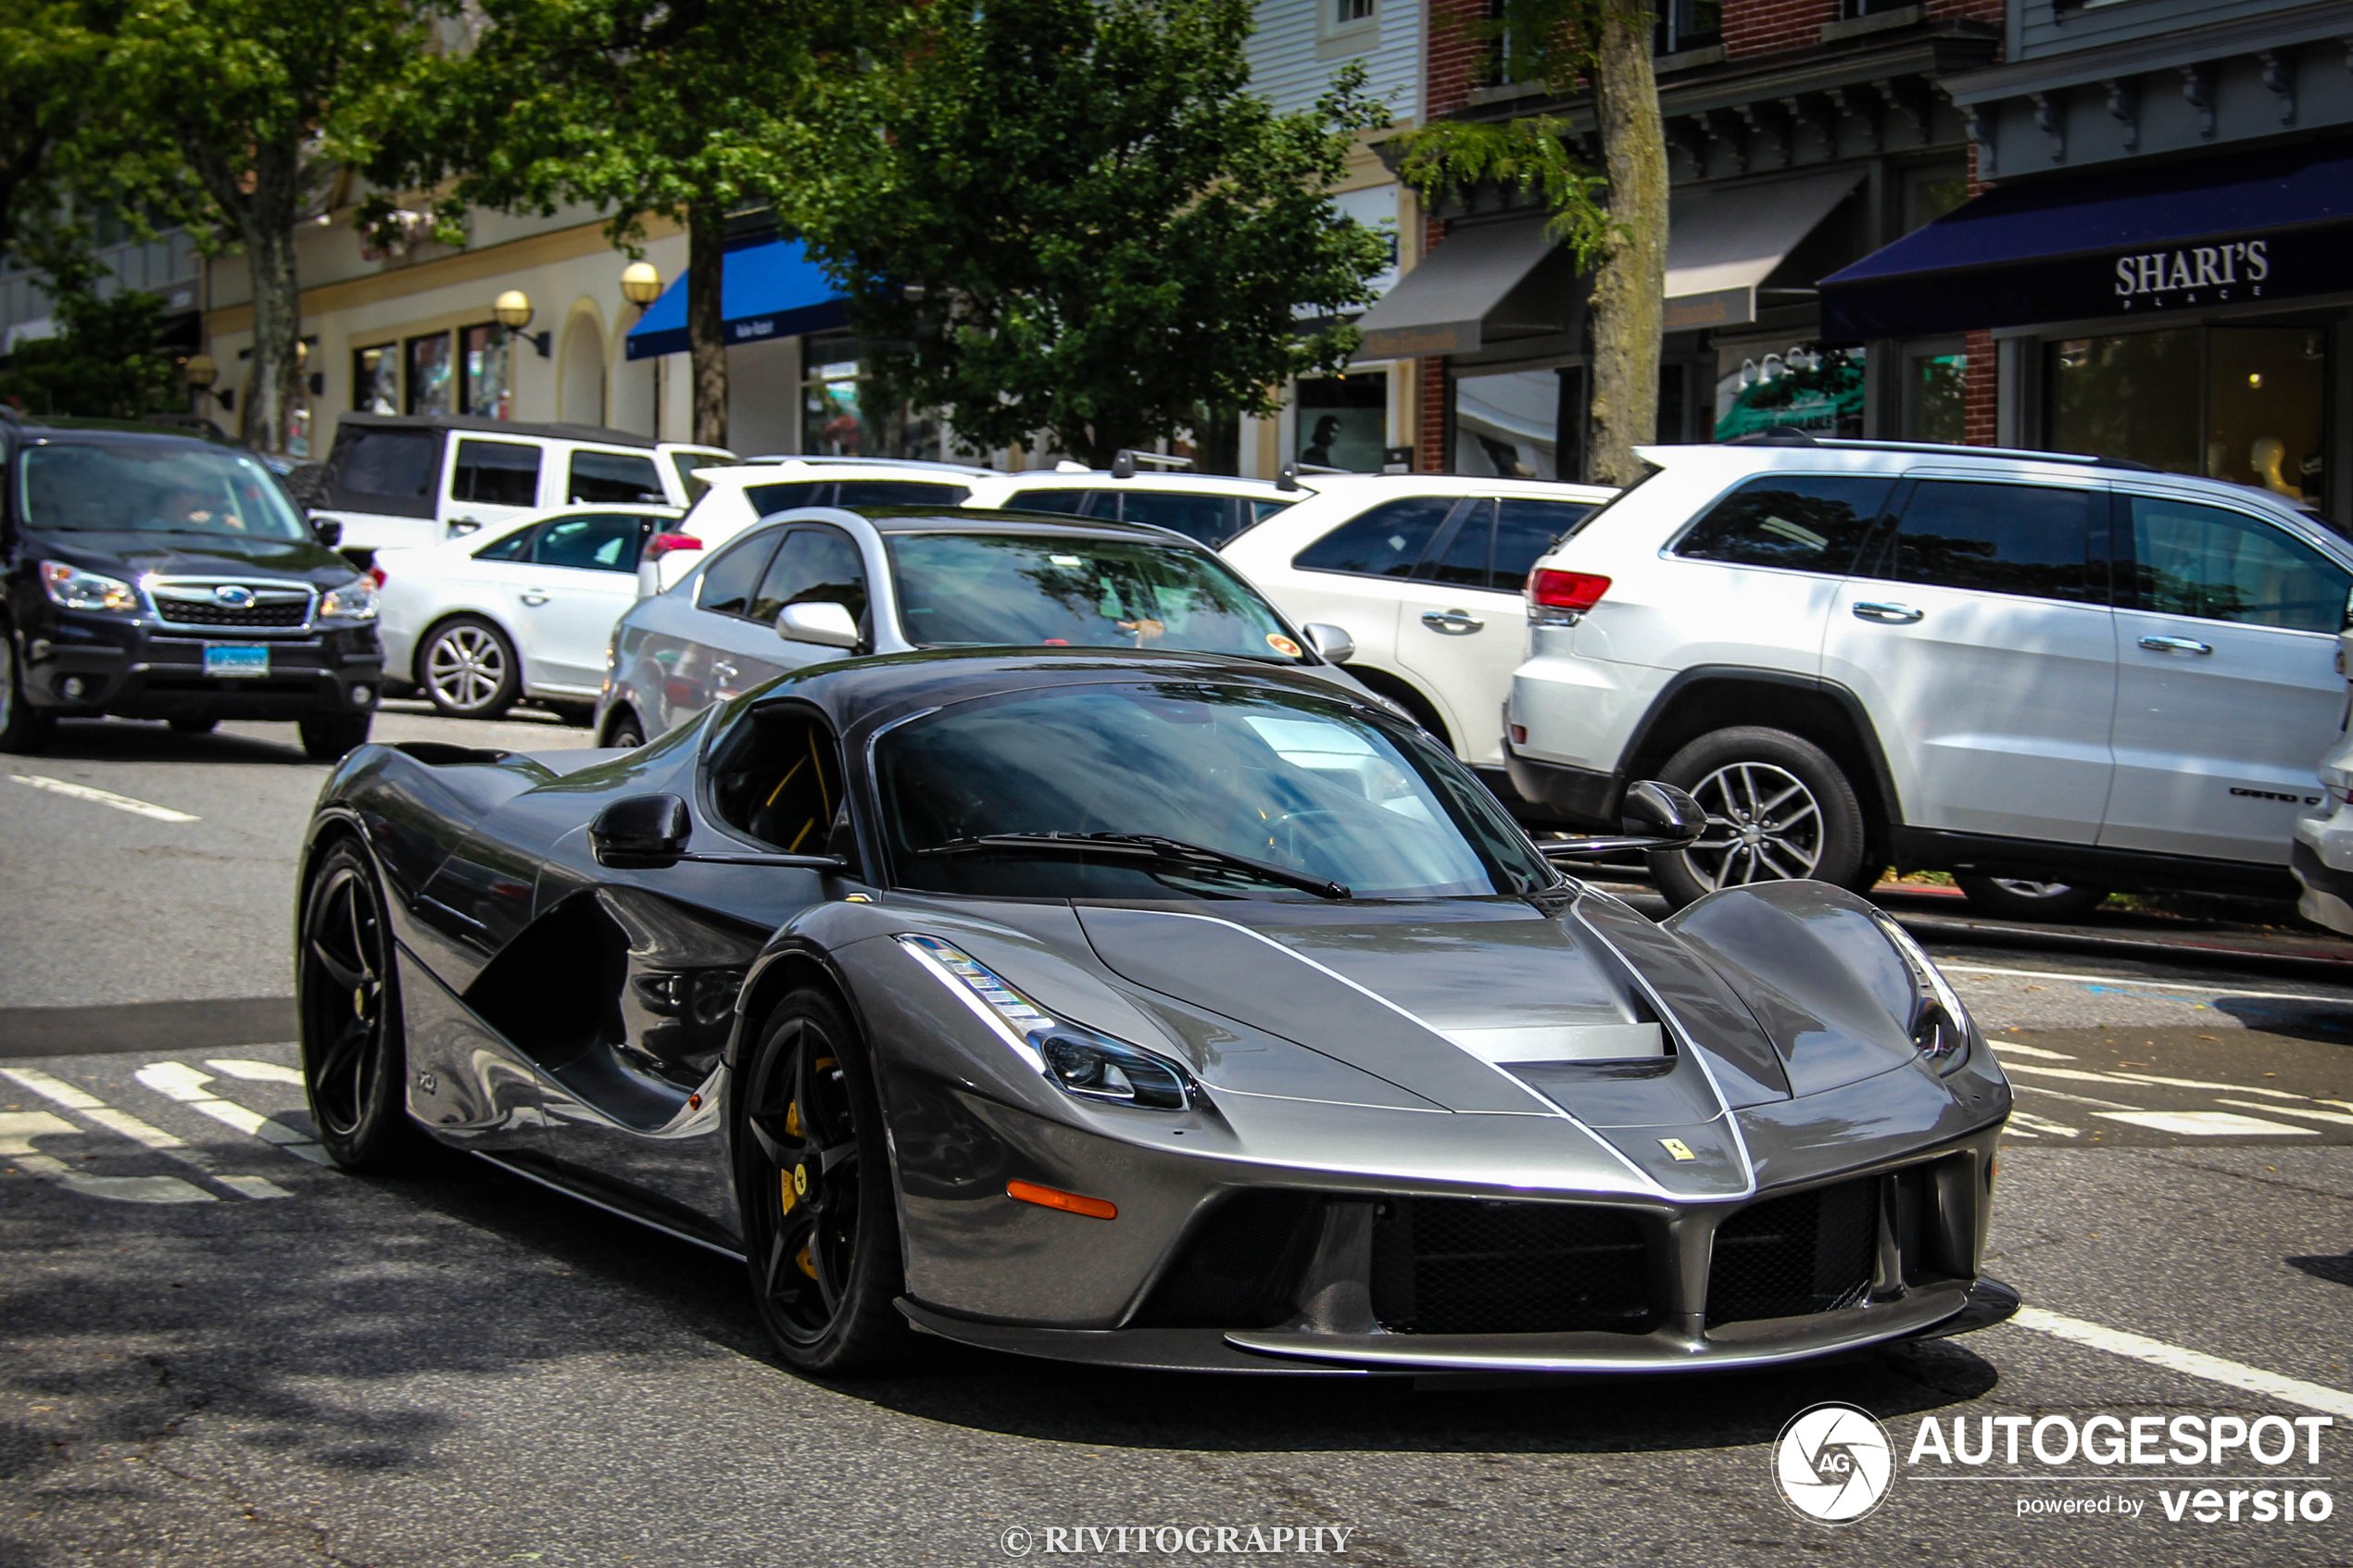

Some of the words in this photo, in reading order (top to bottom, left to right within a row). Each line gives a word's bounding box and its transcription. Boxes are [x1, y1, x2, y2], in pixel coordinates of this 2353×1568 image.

[2115, 240, 2269, 295] SHARI'S
[2123, 285, 2261, 310] PLACE
[2230, 787, 2298, 803] GRAND
